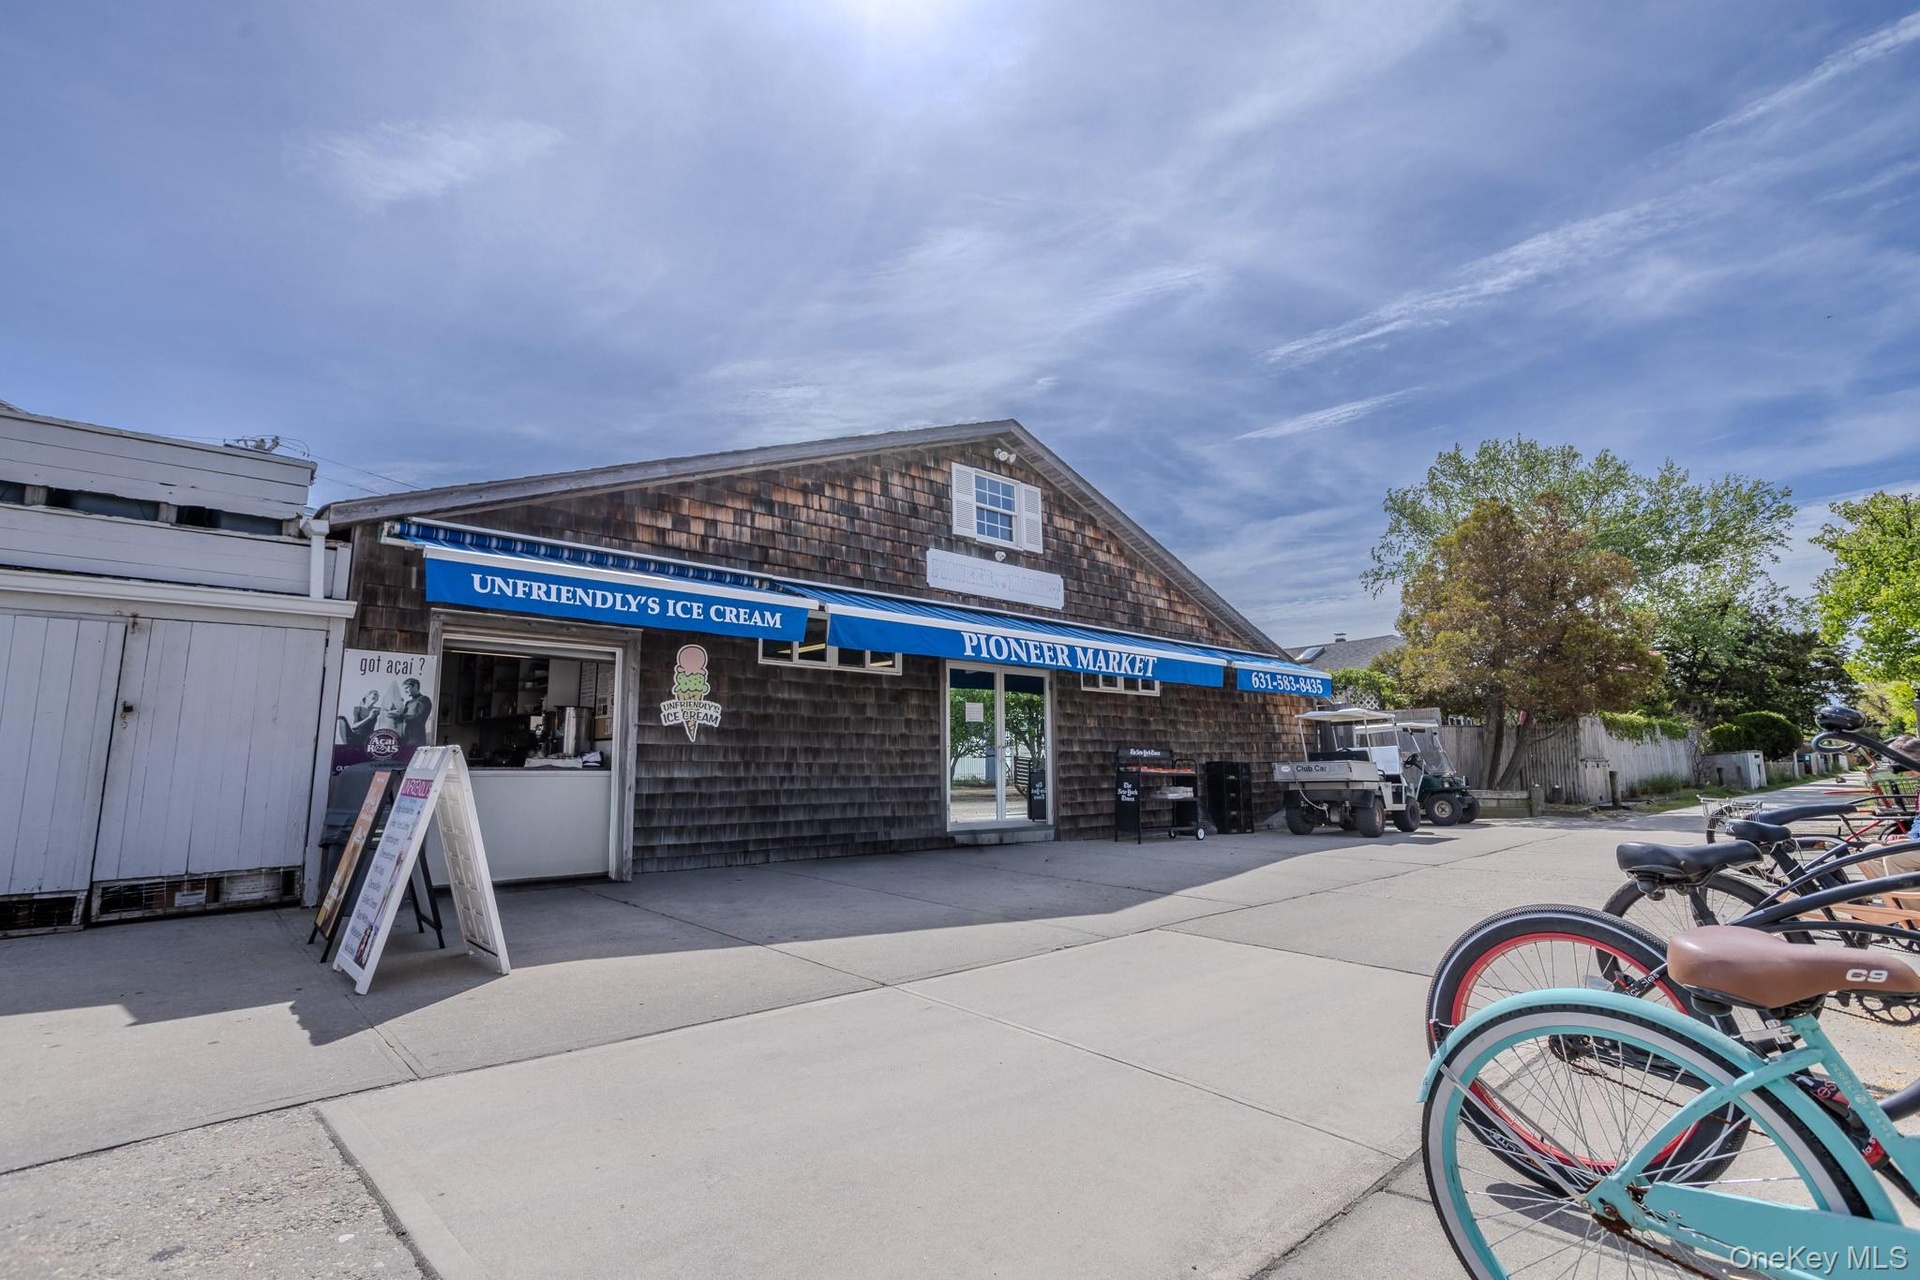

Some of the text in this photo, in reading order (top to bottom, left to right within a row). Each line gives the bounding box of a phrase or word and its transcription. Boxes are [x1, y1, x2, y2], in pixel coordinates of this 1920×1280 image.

[471, 573, 782, 628] UNFRIENDLY'S ICE CREAM
[961, 631, 1157, 677] PIONEER MARKET
[360, 655, 382, 676] got
[418, 657, 426, 676] ?
[1251, 672, 1323, 694] 631-583-8435
[663, 711, 719, 726] ICE CREAM
[1295, 765, 1313, 773] Club
[1314, 764, 1327, 772] Car
[1845, 968, 1889, 983] C9
